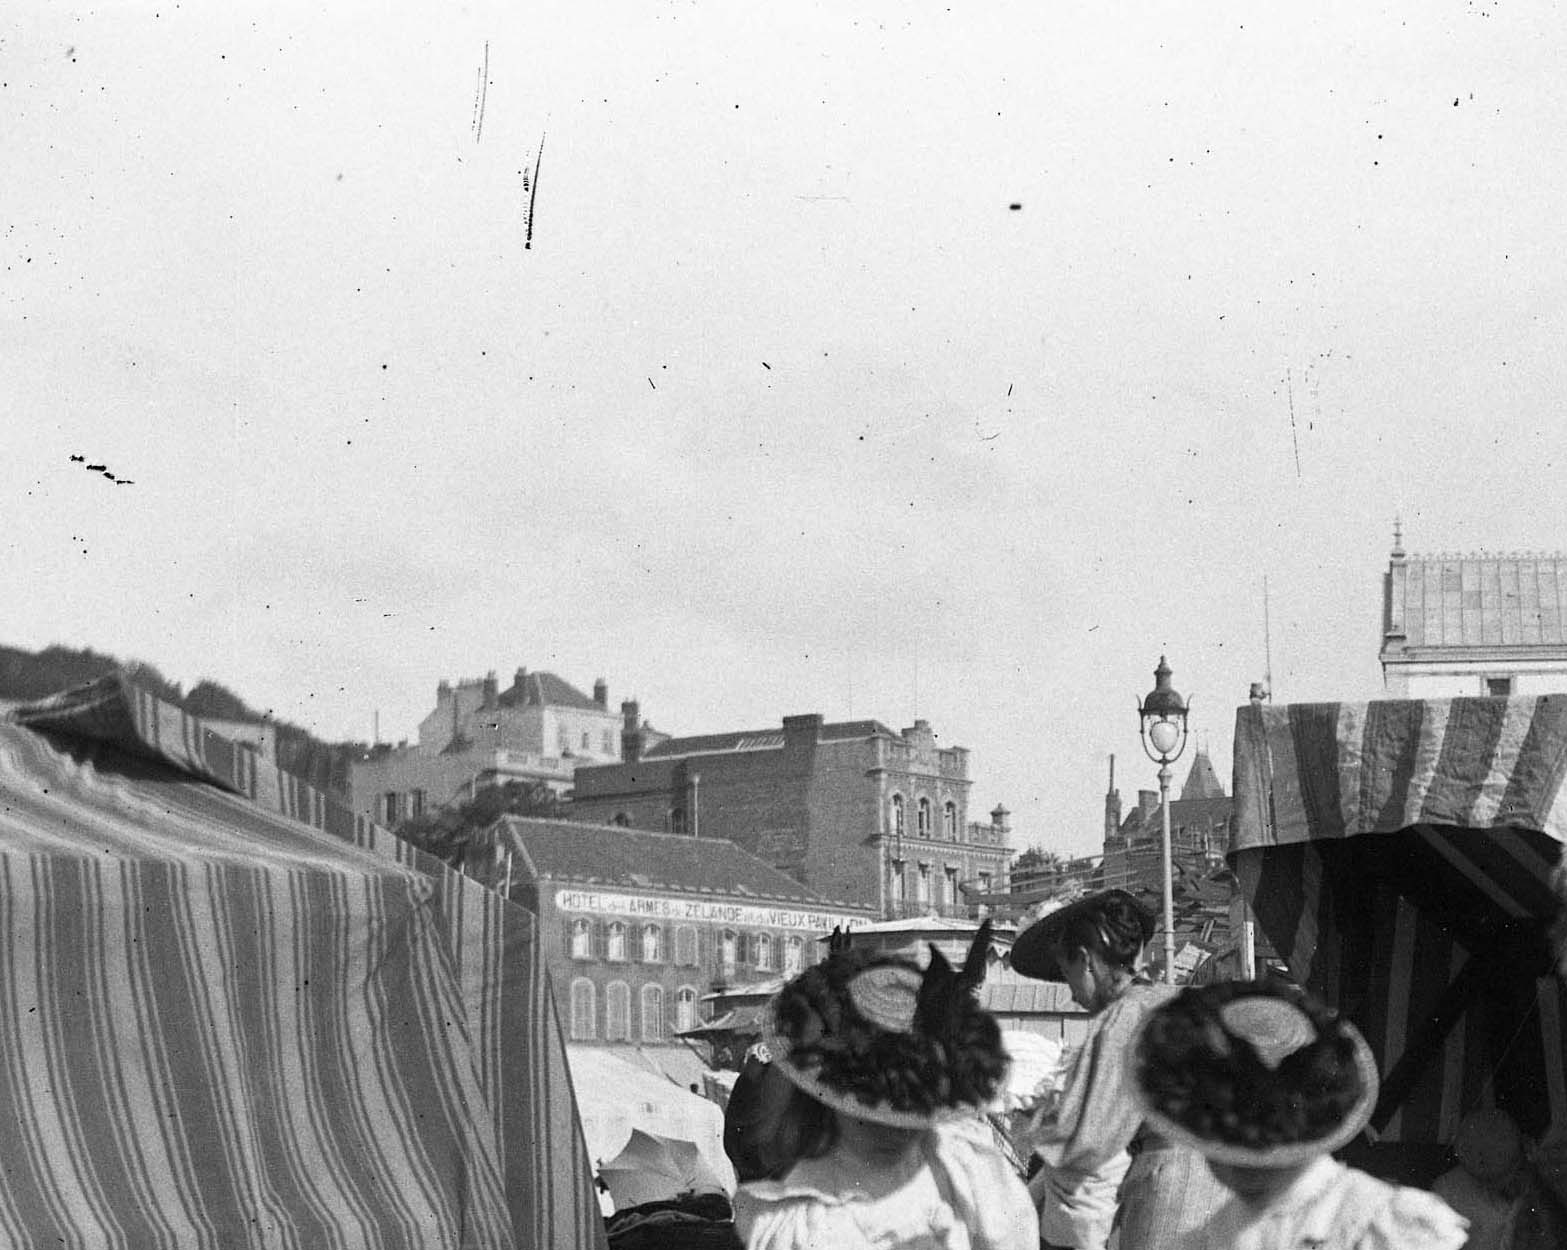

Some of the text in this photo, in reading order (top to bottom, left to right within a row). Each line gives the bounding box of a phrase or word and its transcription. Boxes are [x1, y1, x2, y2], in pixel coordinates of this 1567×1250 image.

[563, 893, 606, 912] HOTEL
[630, 898, 670, 916] ARMES
[685, 903, 742, 922] ZELANDE
[769, 910, 805, 928] VIEUX
